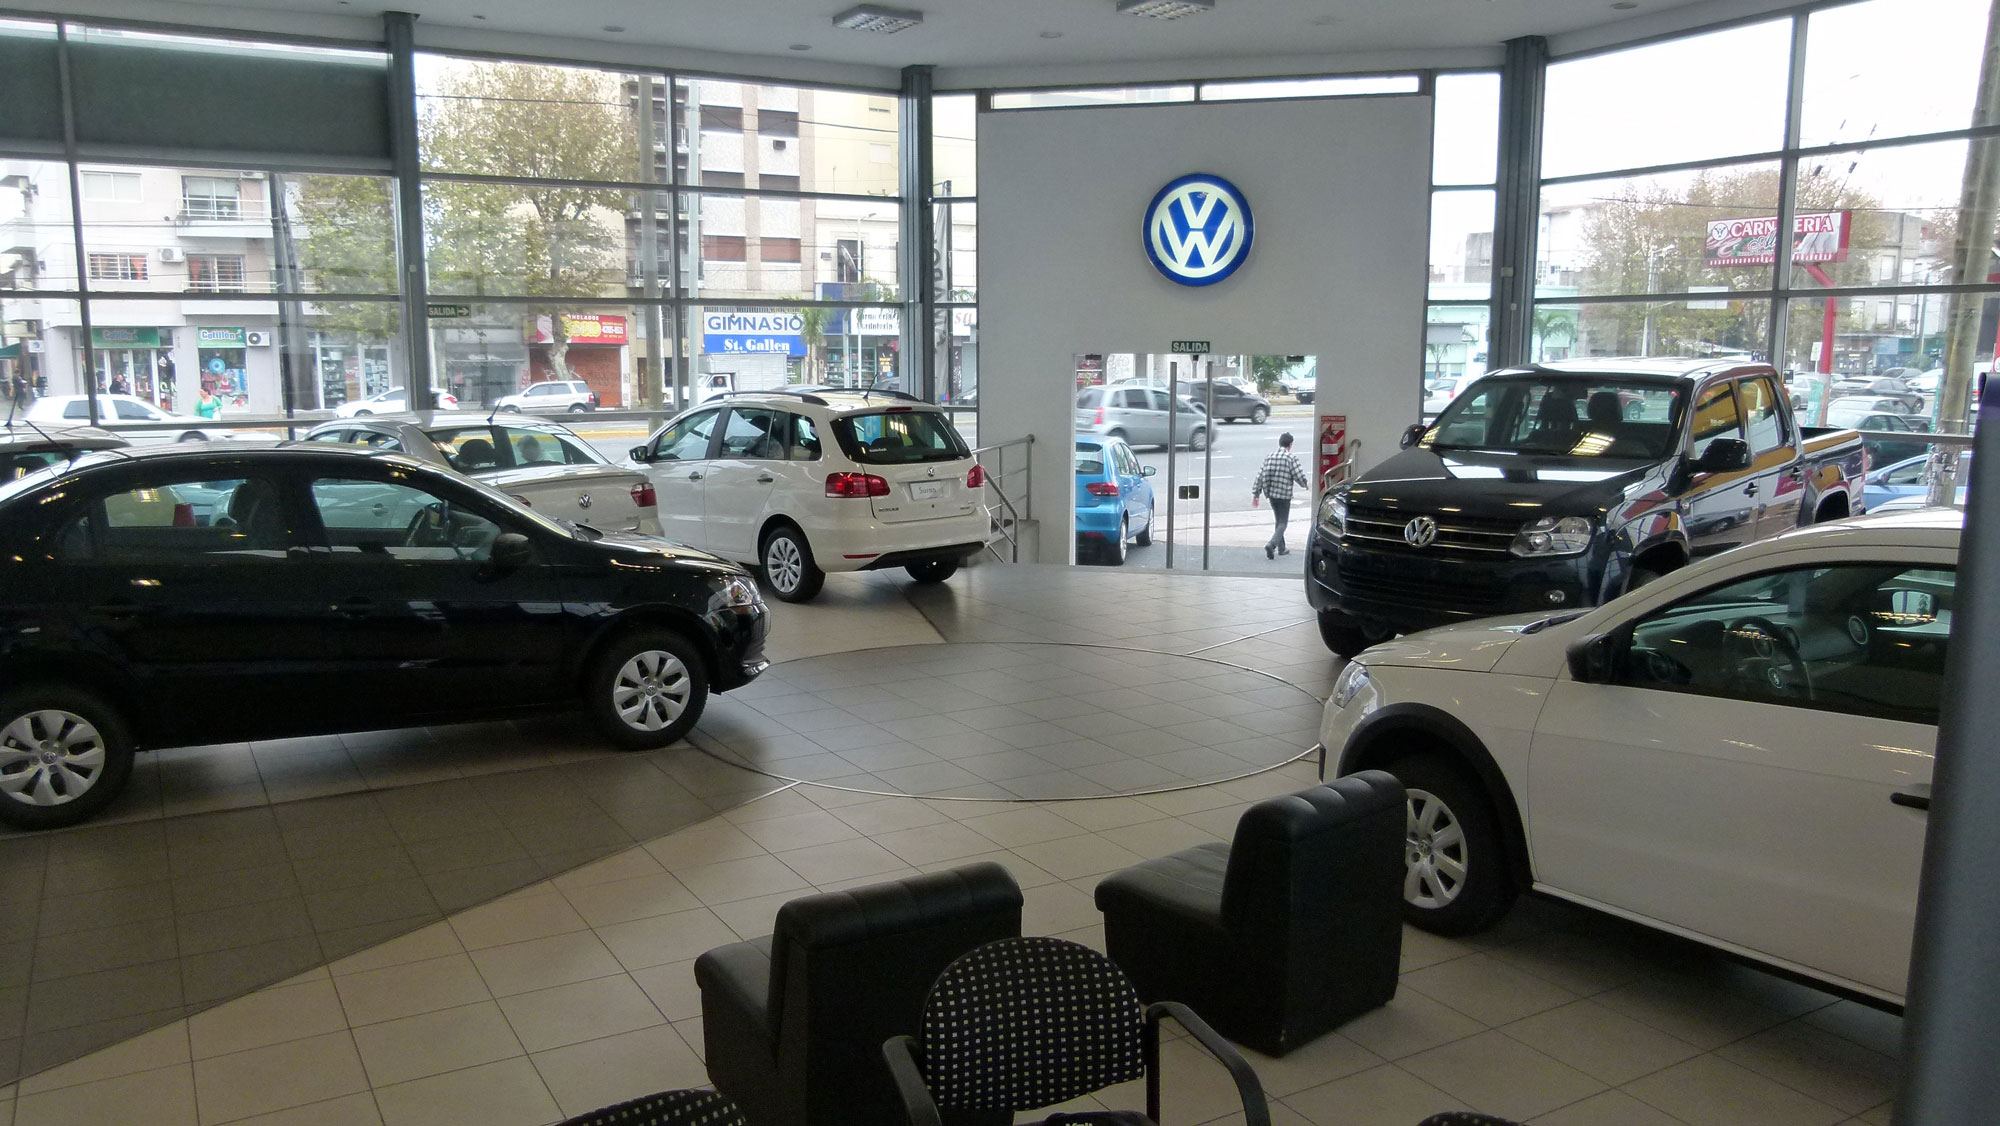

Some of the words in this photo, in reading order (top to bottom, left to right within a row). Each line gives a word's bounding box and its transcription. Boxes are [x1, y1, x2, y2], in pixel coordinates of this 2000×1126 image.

[1729, 216, 1834, 238] CARNERIA
[428, 306, 456, 316] SALIDA
[708, 316, 804, 331] GIMNASIO
[724, 338, 743, 351] St.
[746, 338, 790, 351] Gallen
[1172, 341, 1209, 353] SALIDA
